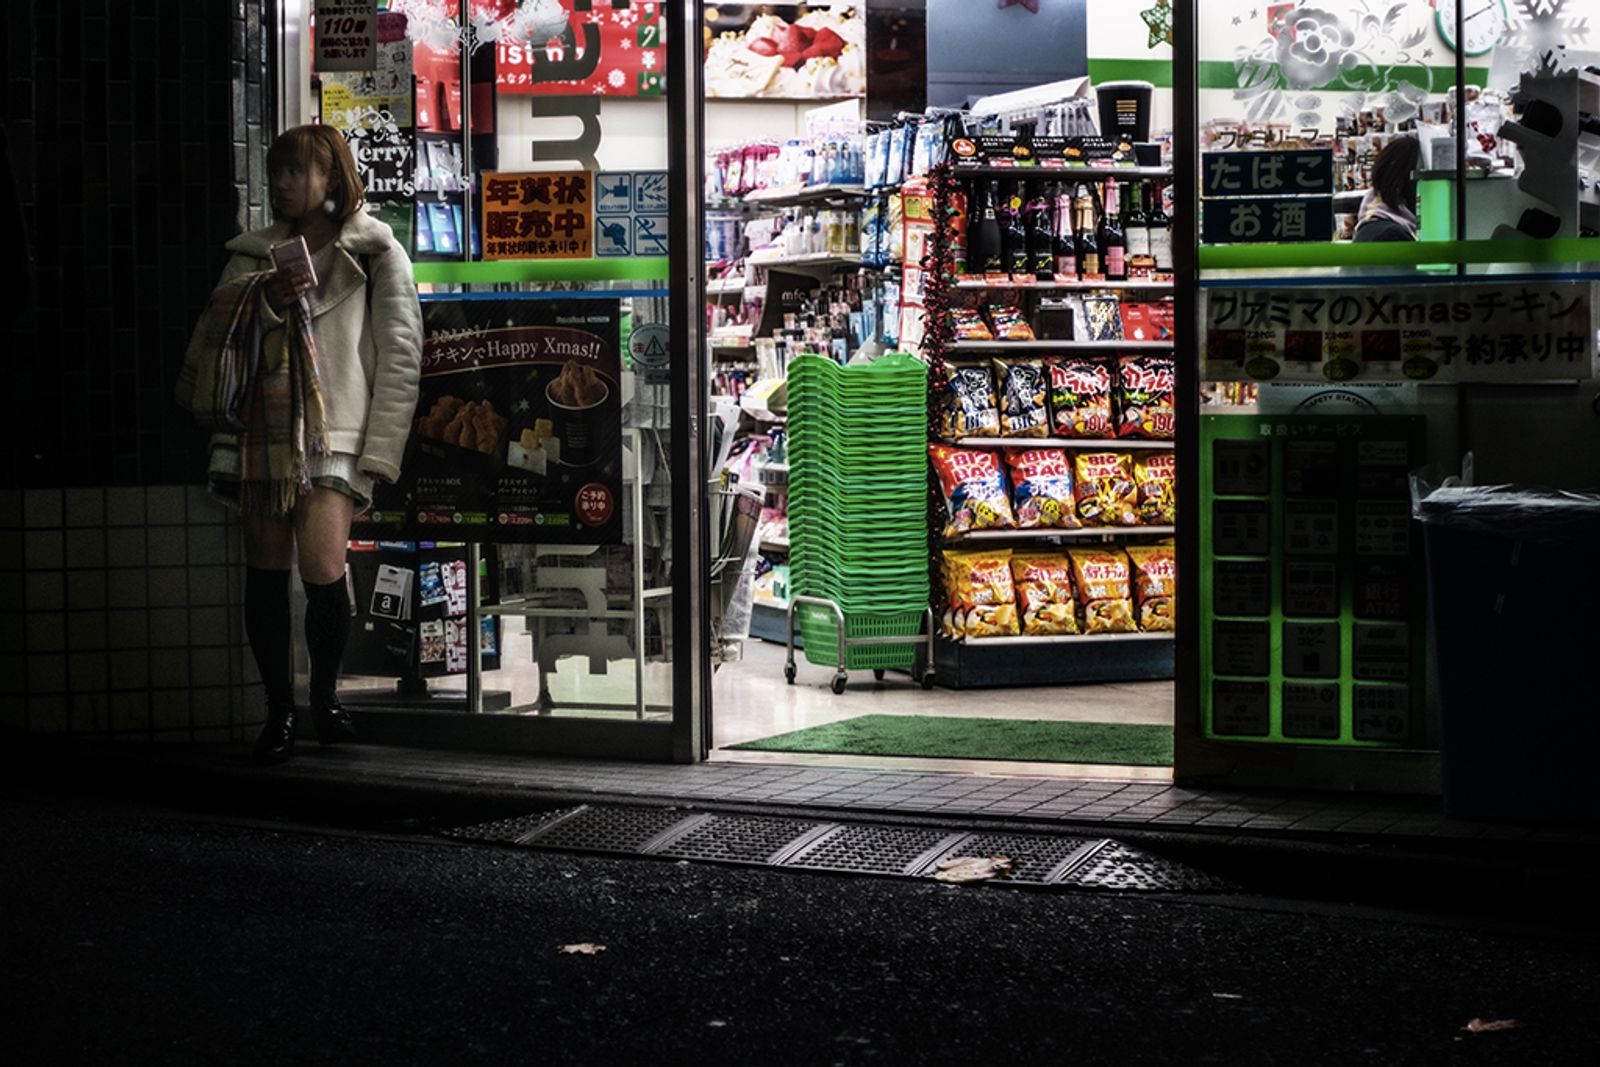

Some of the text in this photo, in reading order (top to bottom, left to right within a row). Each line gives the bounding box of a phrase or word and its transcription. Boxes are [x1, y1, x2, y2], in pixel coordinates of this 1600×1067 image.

[1210, 156, 1326, 191] たばこ
[486, 176, 587, 206] 年賀状
[486, 210, 585, 239] 販売中
[1229, 203, 1308, 238] お酒
[1434, 332, 1586, 365] 予約承り中
[1023, 463, 1066, 479] BAG
